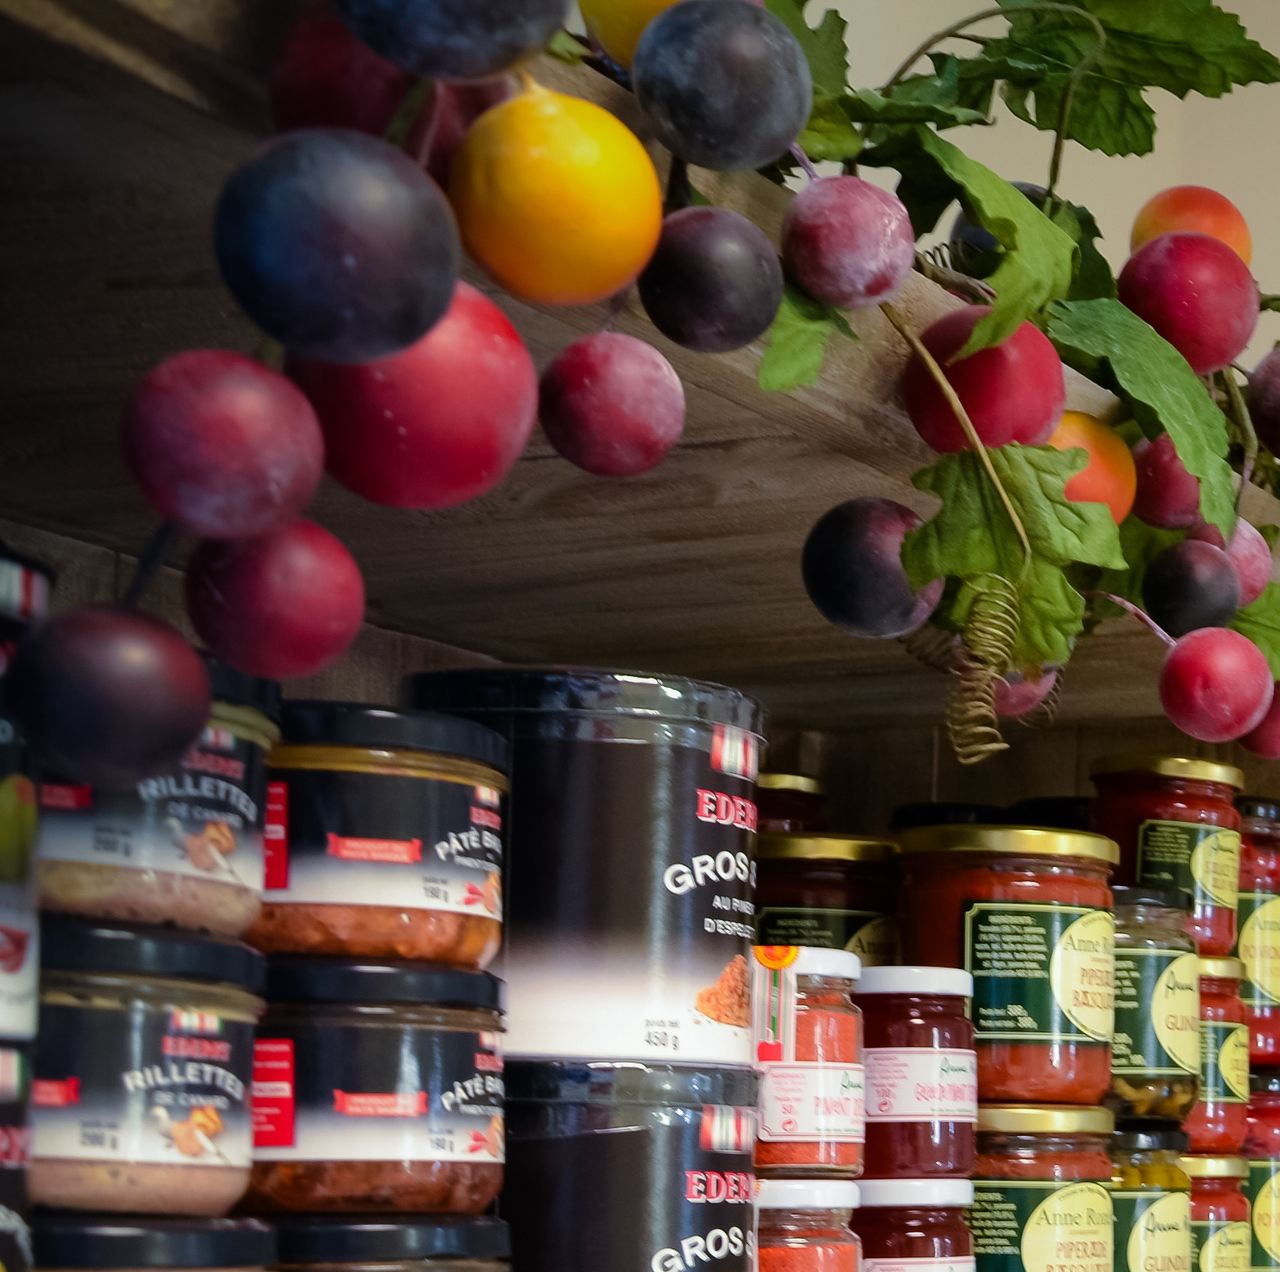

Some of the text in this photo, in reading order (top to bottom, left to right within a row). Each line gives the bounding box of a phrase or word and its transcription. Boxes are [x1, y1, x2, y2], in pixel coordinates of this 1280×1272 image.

[137, 774, 257, 822] RILLETTES
[663, 849, 749, 896] GROS
[712, 895, 730, 912] AU
[122, 1062, 244, 1101] RILLETTES
